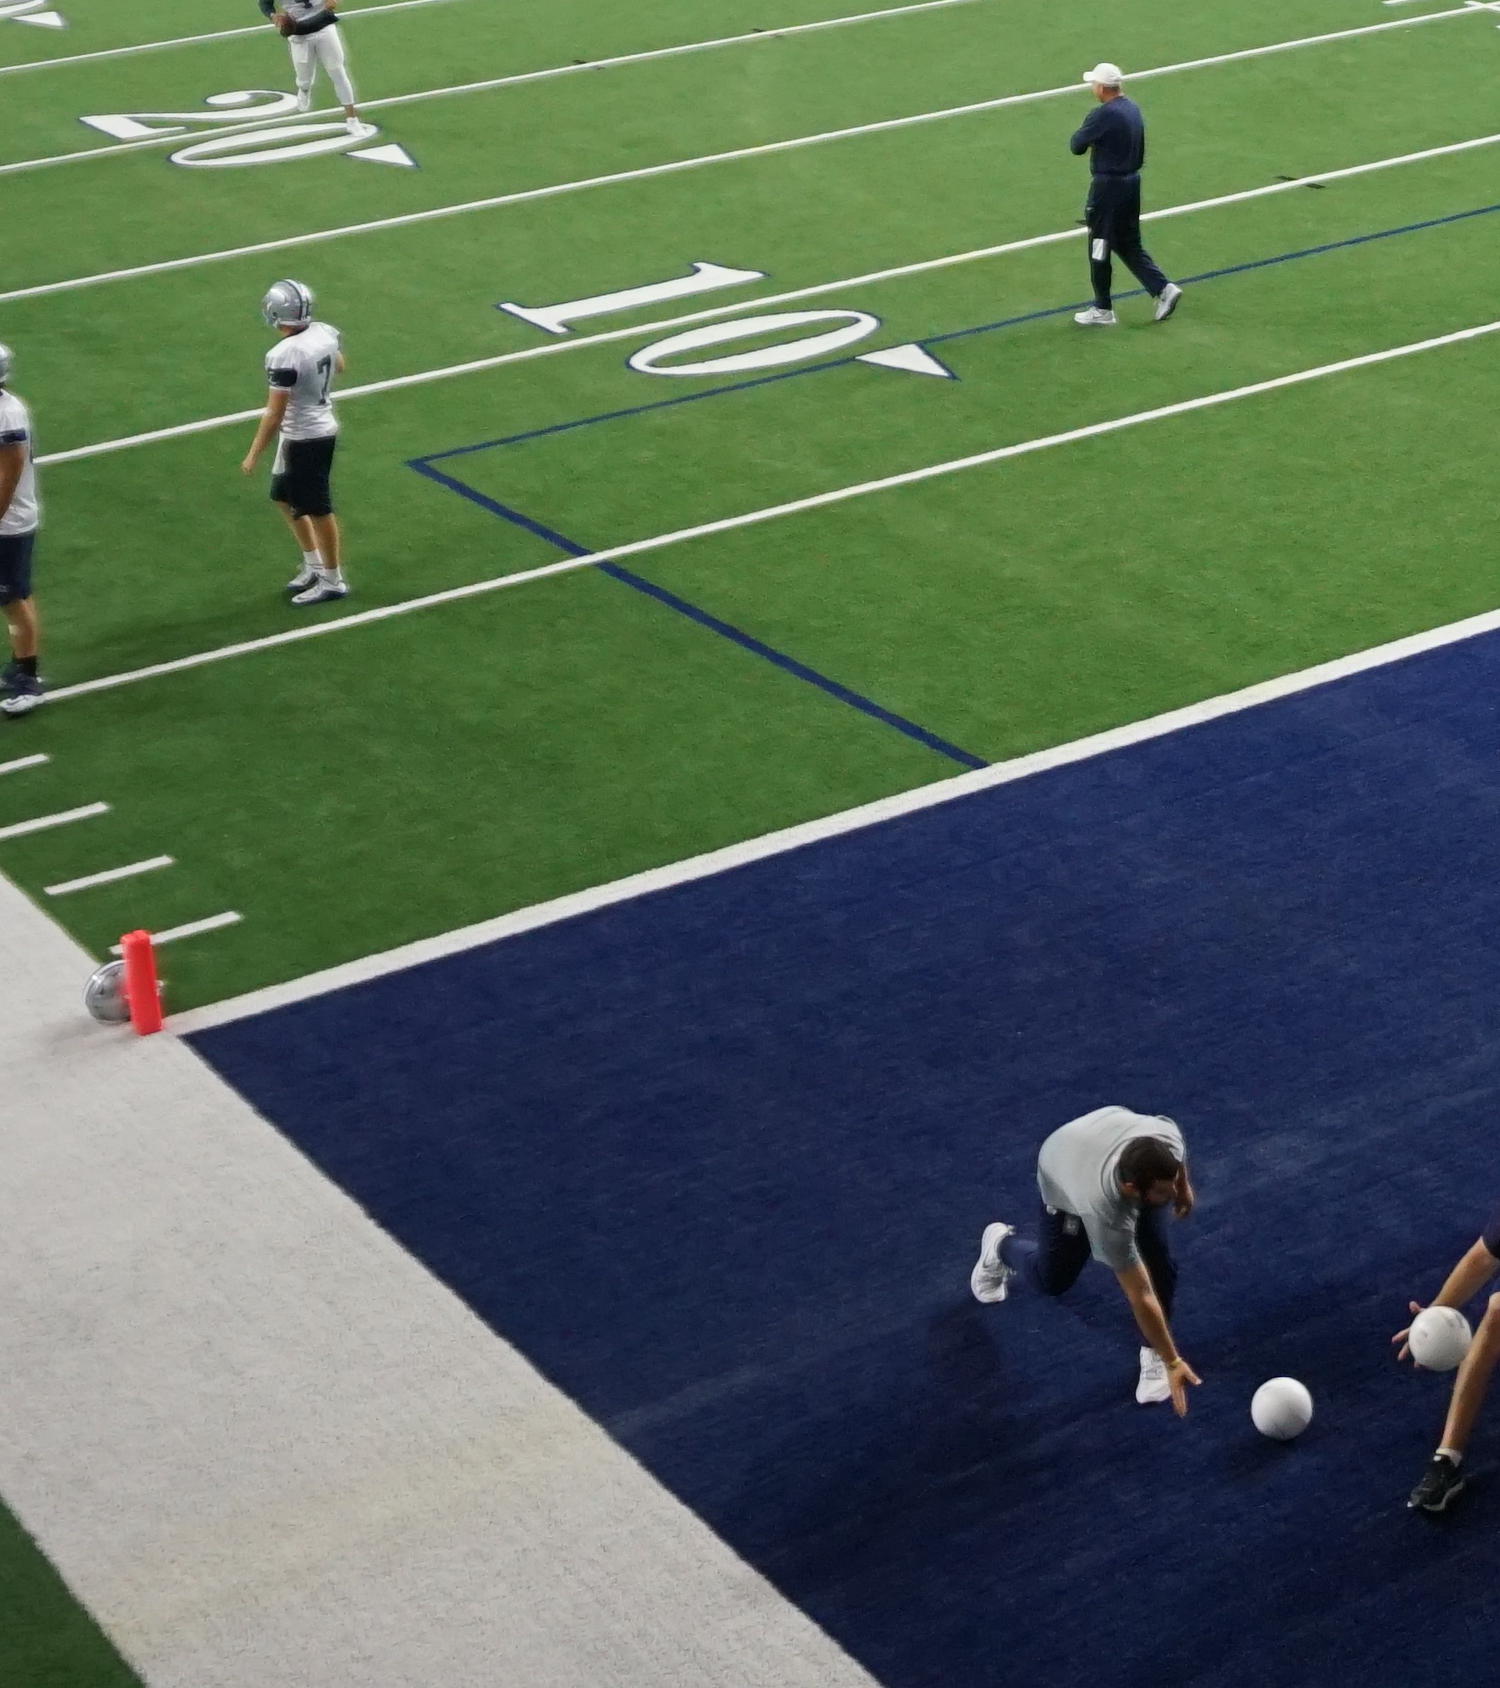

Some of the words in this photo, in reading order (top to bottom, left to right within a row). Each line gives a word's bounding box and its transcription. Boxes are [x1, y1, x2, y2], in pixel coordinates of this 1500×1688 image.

[79, 88, 380, 168] 20
[495, 259, 882, 378] 10
[316, 354, 332, 404] 7
